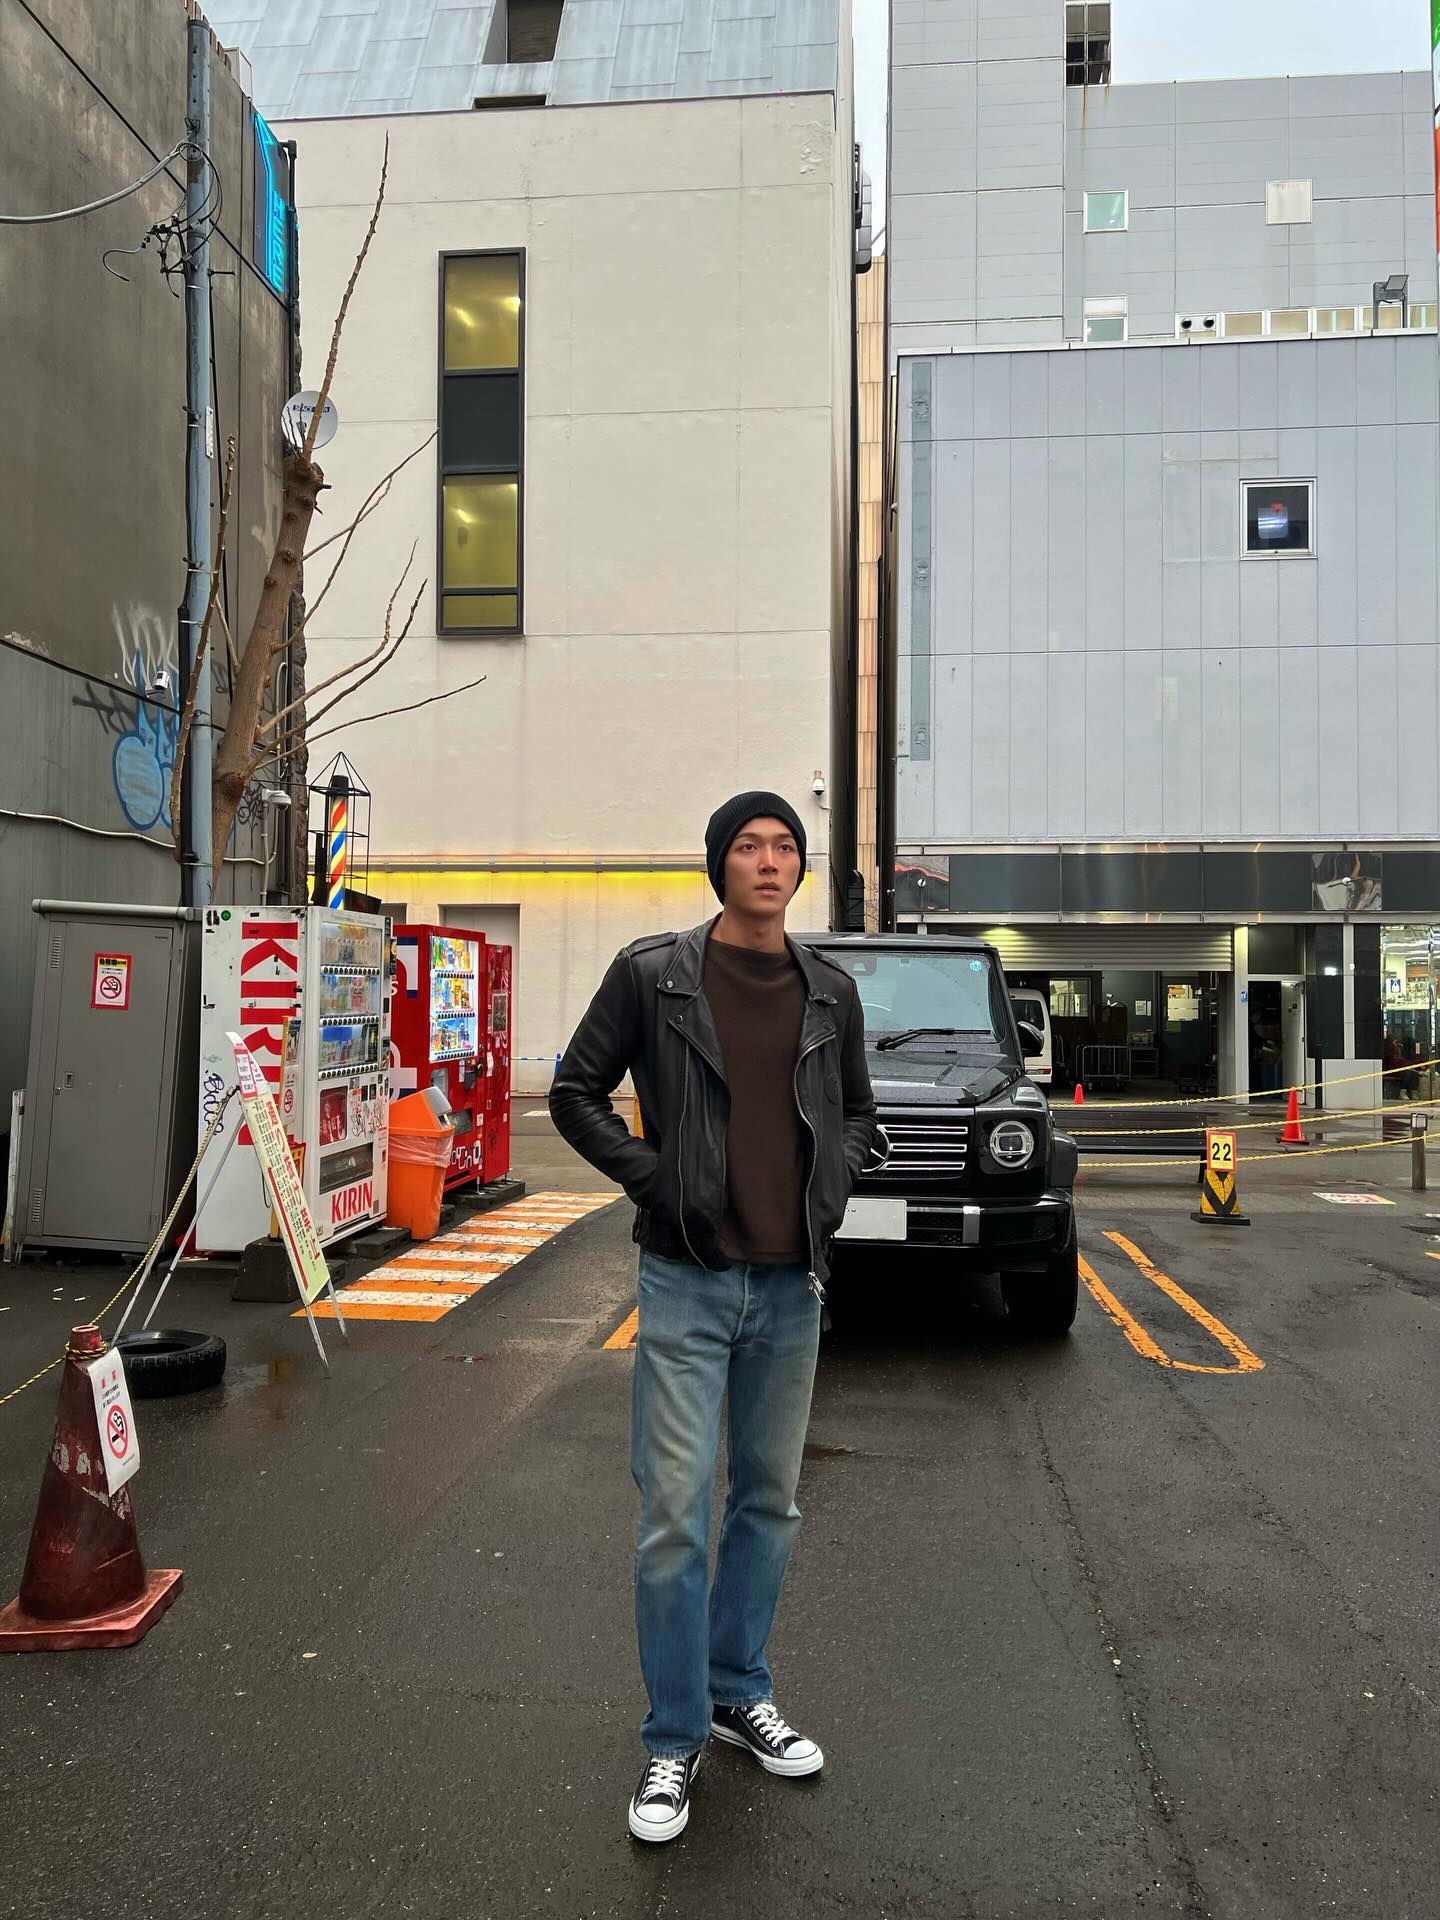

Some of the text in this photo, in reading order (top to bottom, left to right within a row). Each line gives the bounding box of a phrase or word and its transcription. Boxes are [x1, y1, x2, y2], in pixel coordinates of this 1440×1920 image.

[238, 921, 298, 1146] KIR
[1212, 1142, 1232, 1161] 22
[331, 1180, 373, 1224] KIRIN
